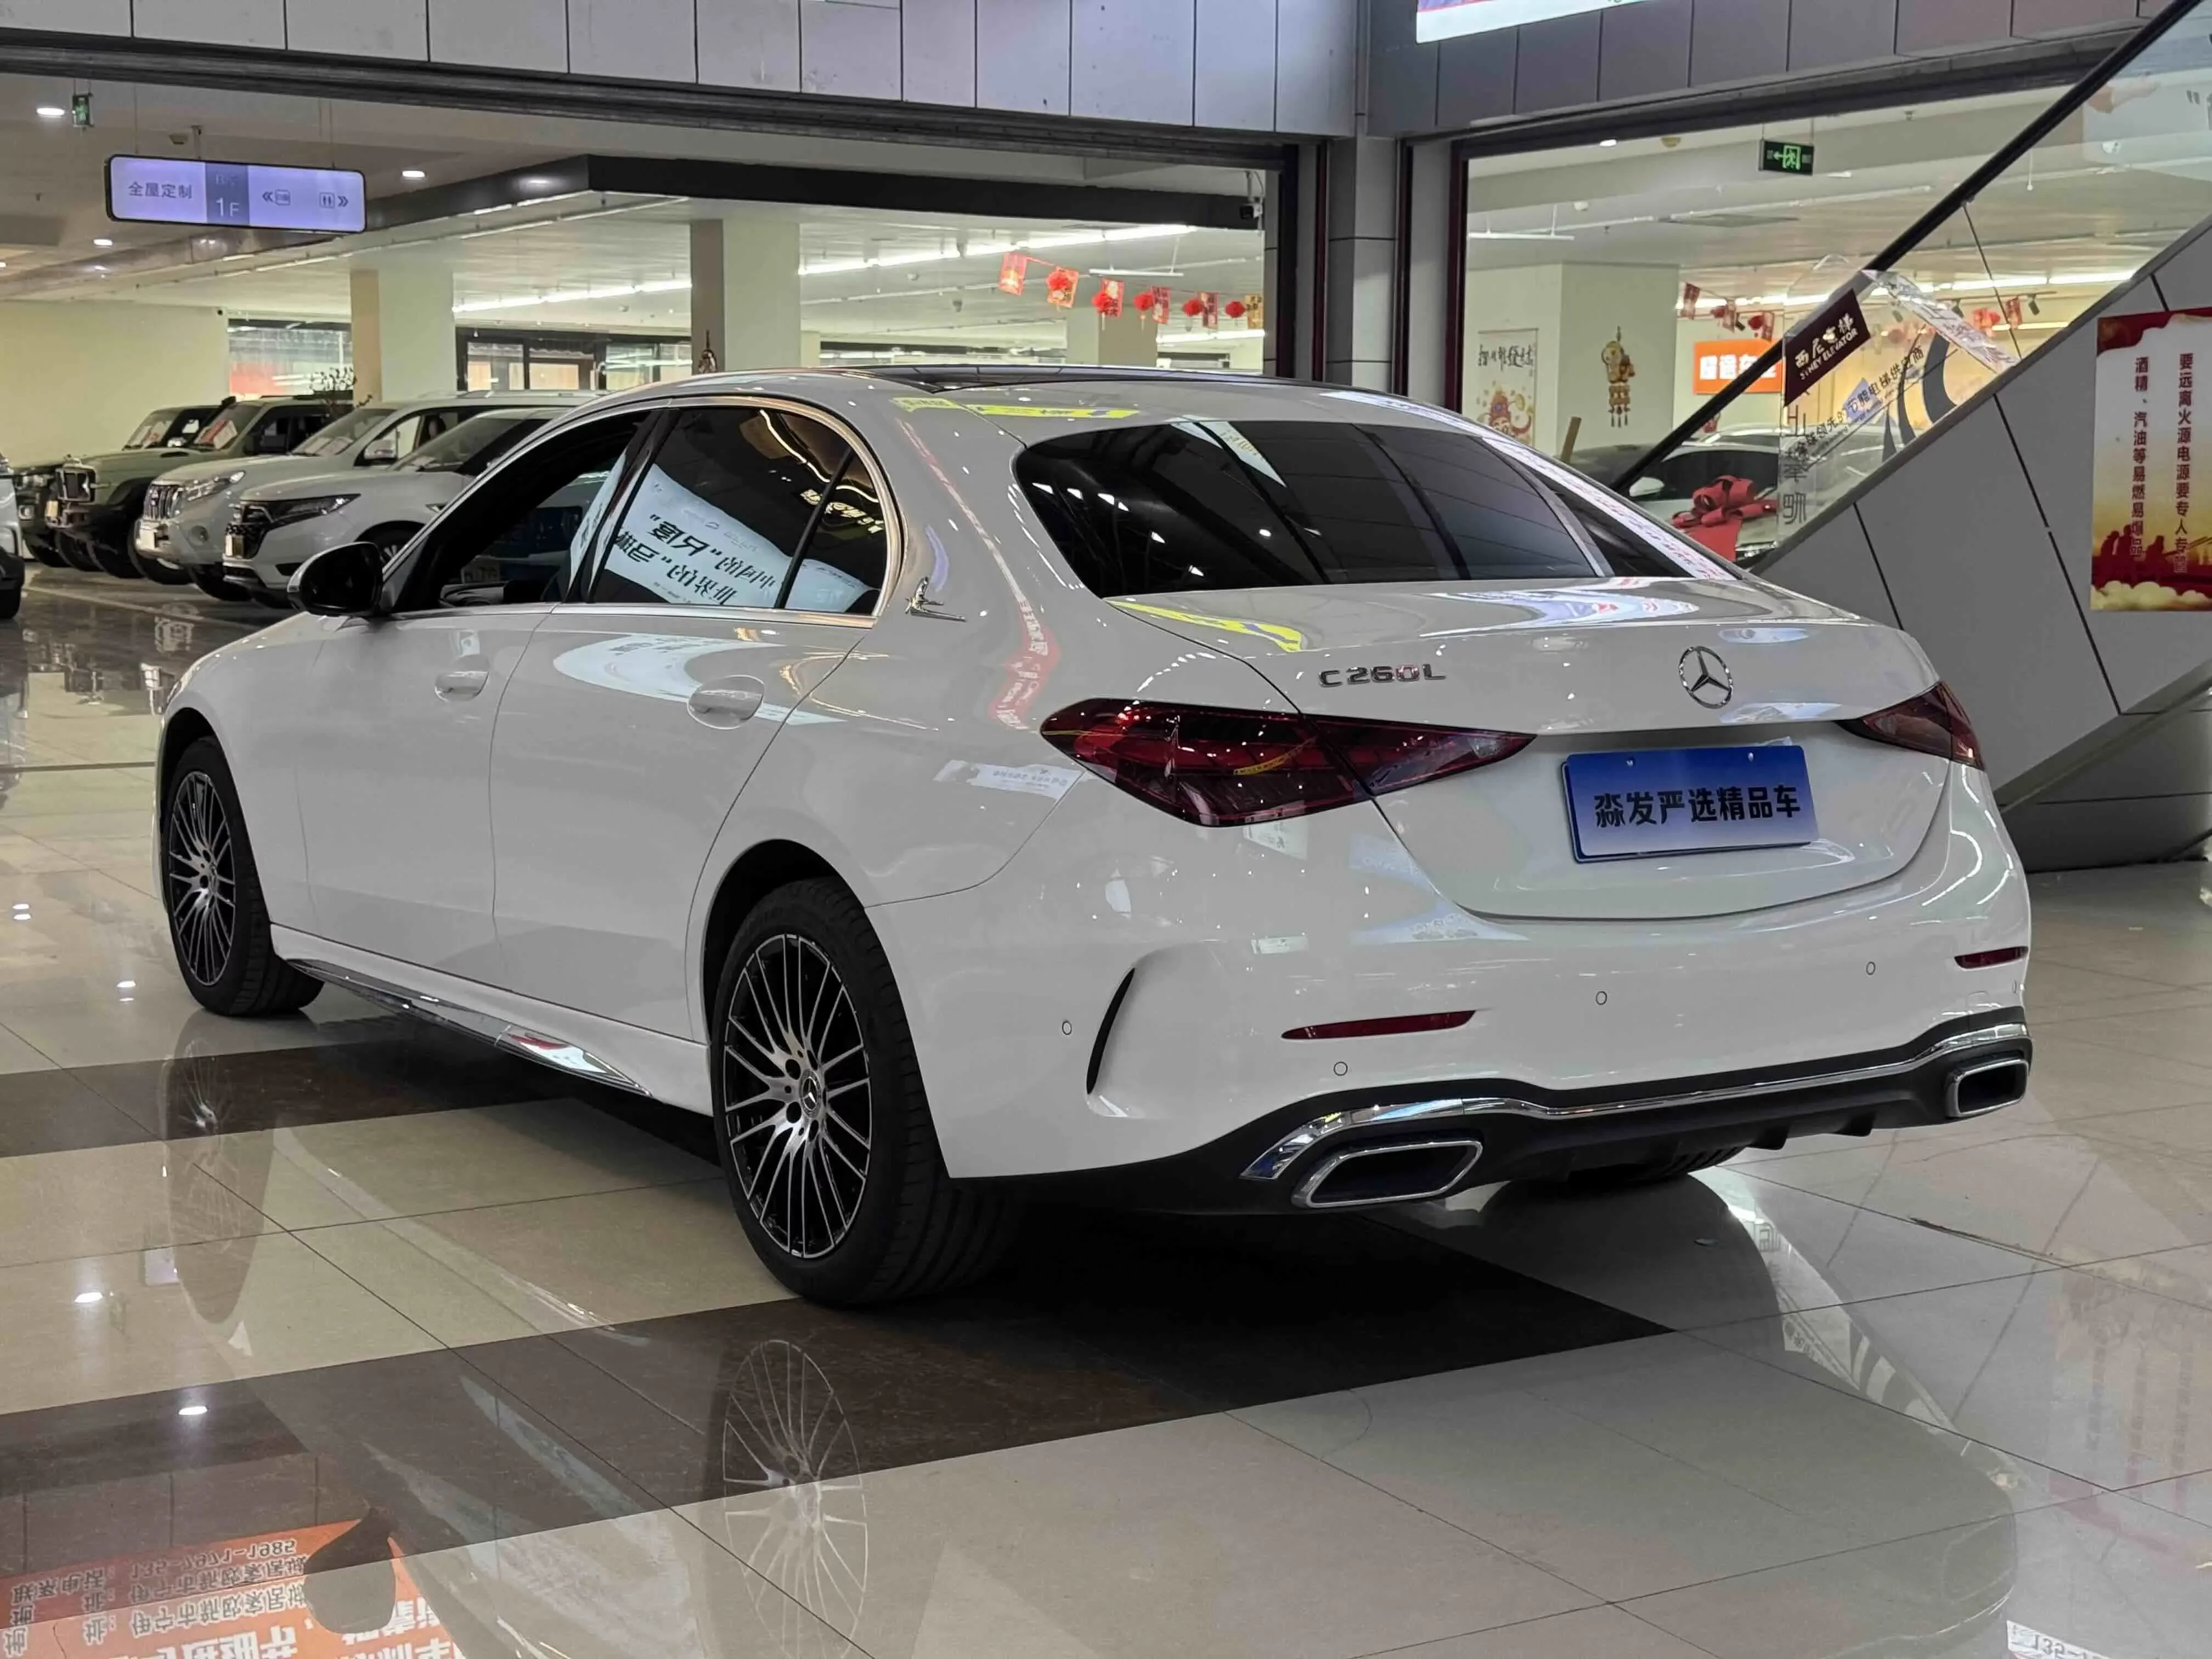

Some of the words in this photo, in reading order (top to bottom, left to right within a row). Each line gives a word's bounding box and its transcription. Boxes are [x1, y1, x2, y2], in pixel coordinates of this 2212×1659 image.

[128, 181, 192, 200] 全屋定制
[216, 197, 240, 217] 1F
[2174, 353, 2193, 573] 要远离火源电源要专人专管
[1594, 785, 1801, 827] 淼发严选精品车
